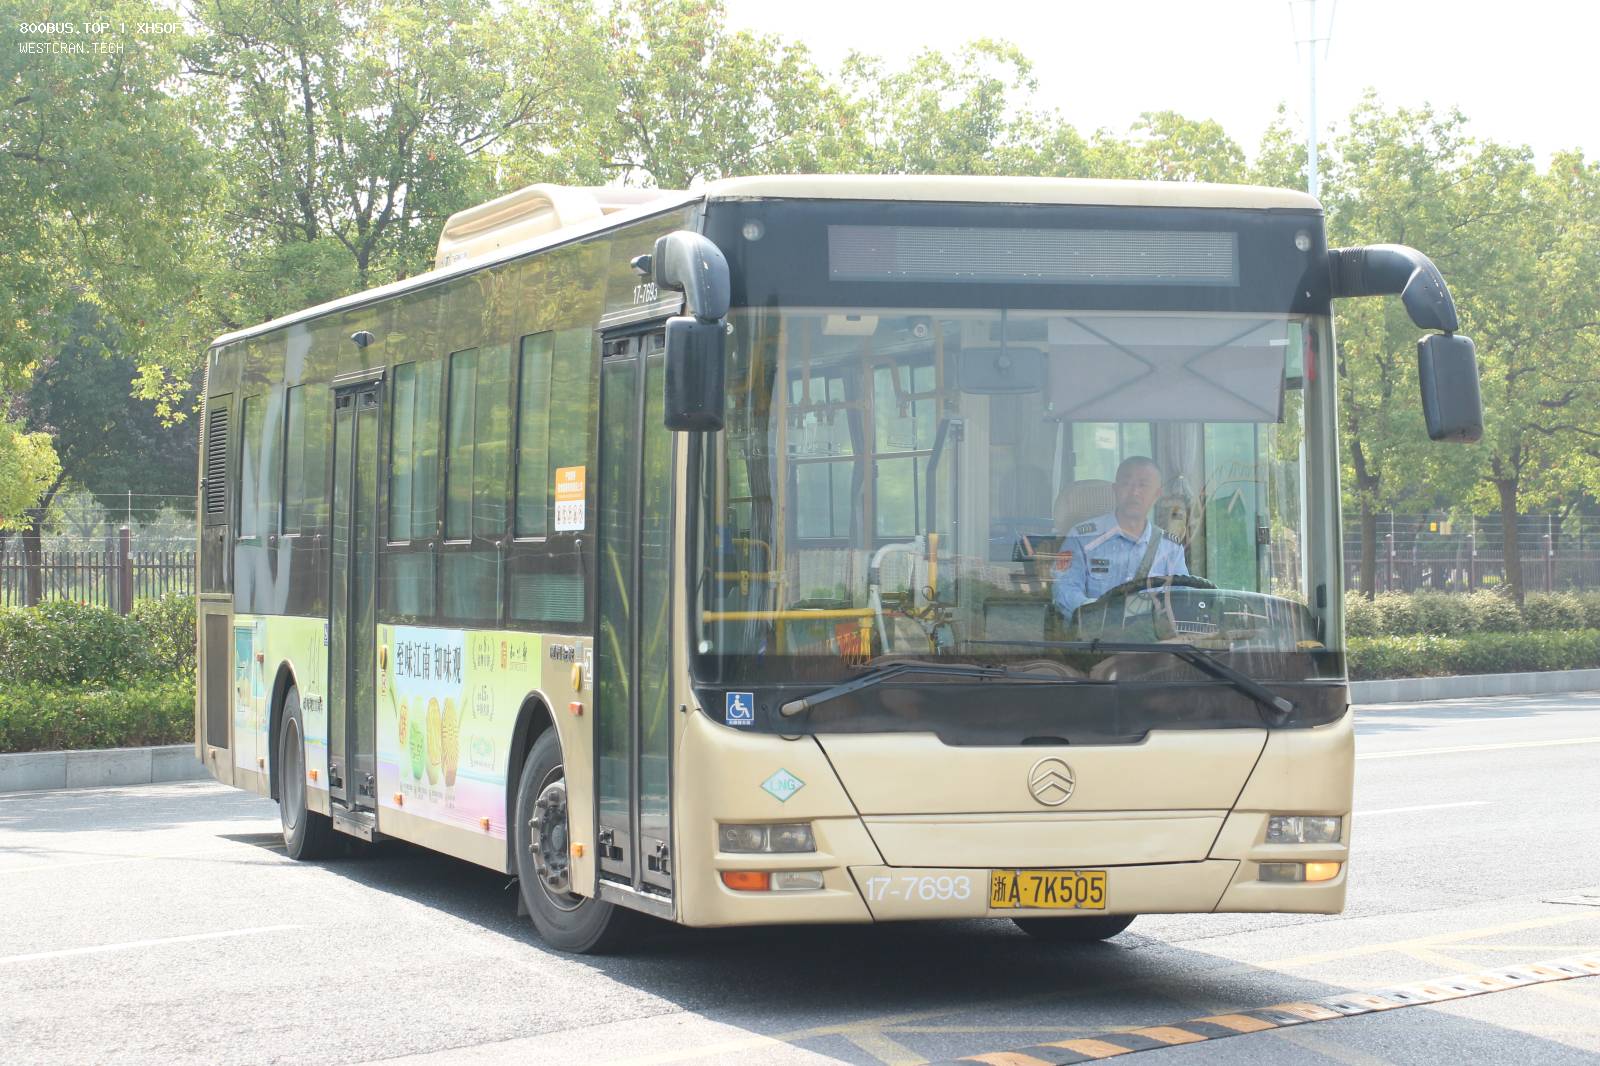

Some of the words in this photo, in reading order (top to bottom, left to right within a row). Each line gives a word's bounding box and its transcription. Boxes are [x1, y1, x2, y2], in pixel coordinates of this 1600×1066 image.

[633, 281, 658, 305] 17-7693
[395, 640, 431, 680] 至味江南
[434, 643, 462, 684] 知味观
[769, 778, 796, 791] LNG
[866, 876, 971, 901] 17-7693
[993, 876, 1104, 904] 浙A·7K505
